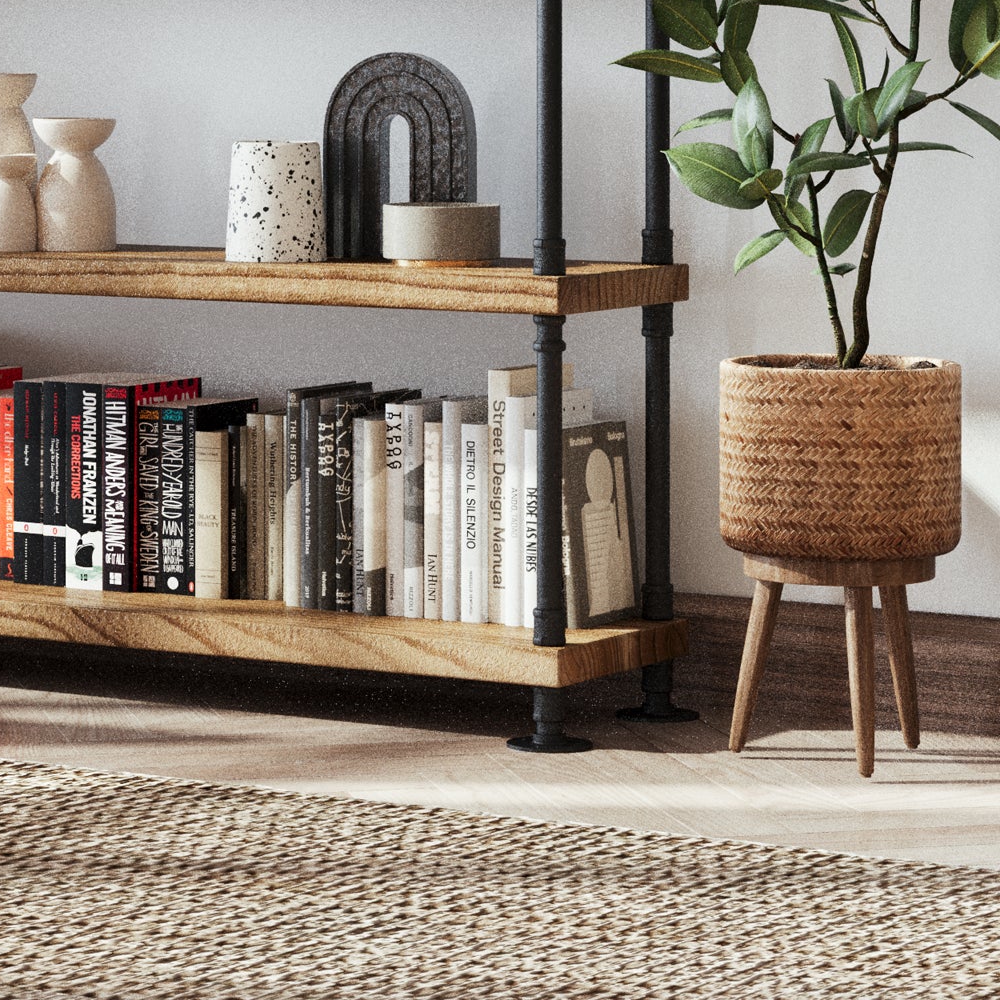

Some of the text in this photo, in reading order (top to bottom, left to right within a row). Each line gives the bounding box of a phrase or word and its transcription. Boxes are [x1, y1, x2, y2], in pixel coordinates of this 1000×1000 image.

[71, 415, 80, 499] THE CORRECTIONS
[82, 390, 96, 524] JONATHAN FRANZEN
[105, 401, 126, 551] HITMAN ANDERS MEANING
[188, 465, 194, 473] IN
[393, 412, 402, 470] TYPOG
[269, 442, 277, 525] Wuthering Heights
[466, 441, 475, 549] DIETRO IL SILENZIO
[490, 400, 506, 590] Street Design Manual
[427, 554, 438, 603] IAN HUNT
